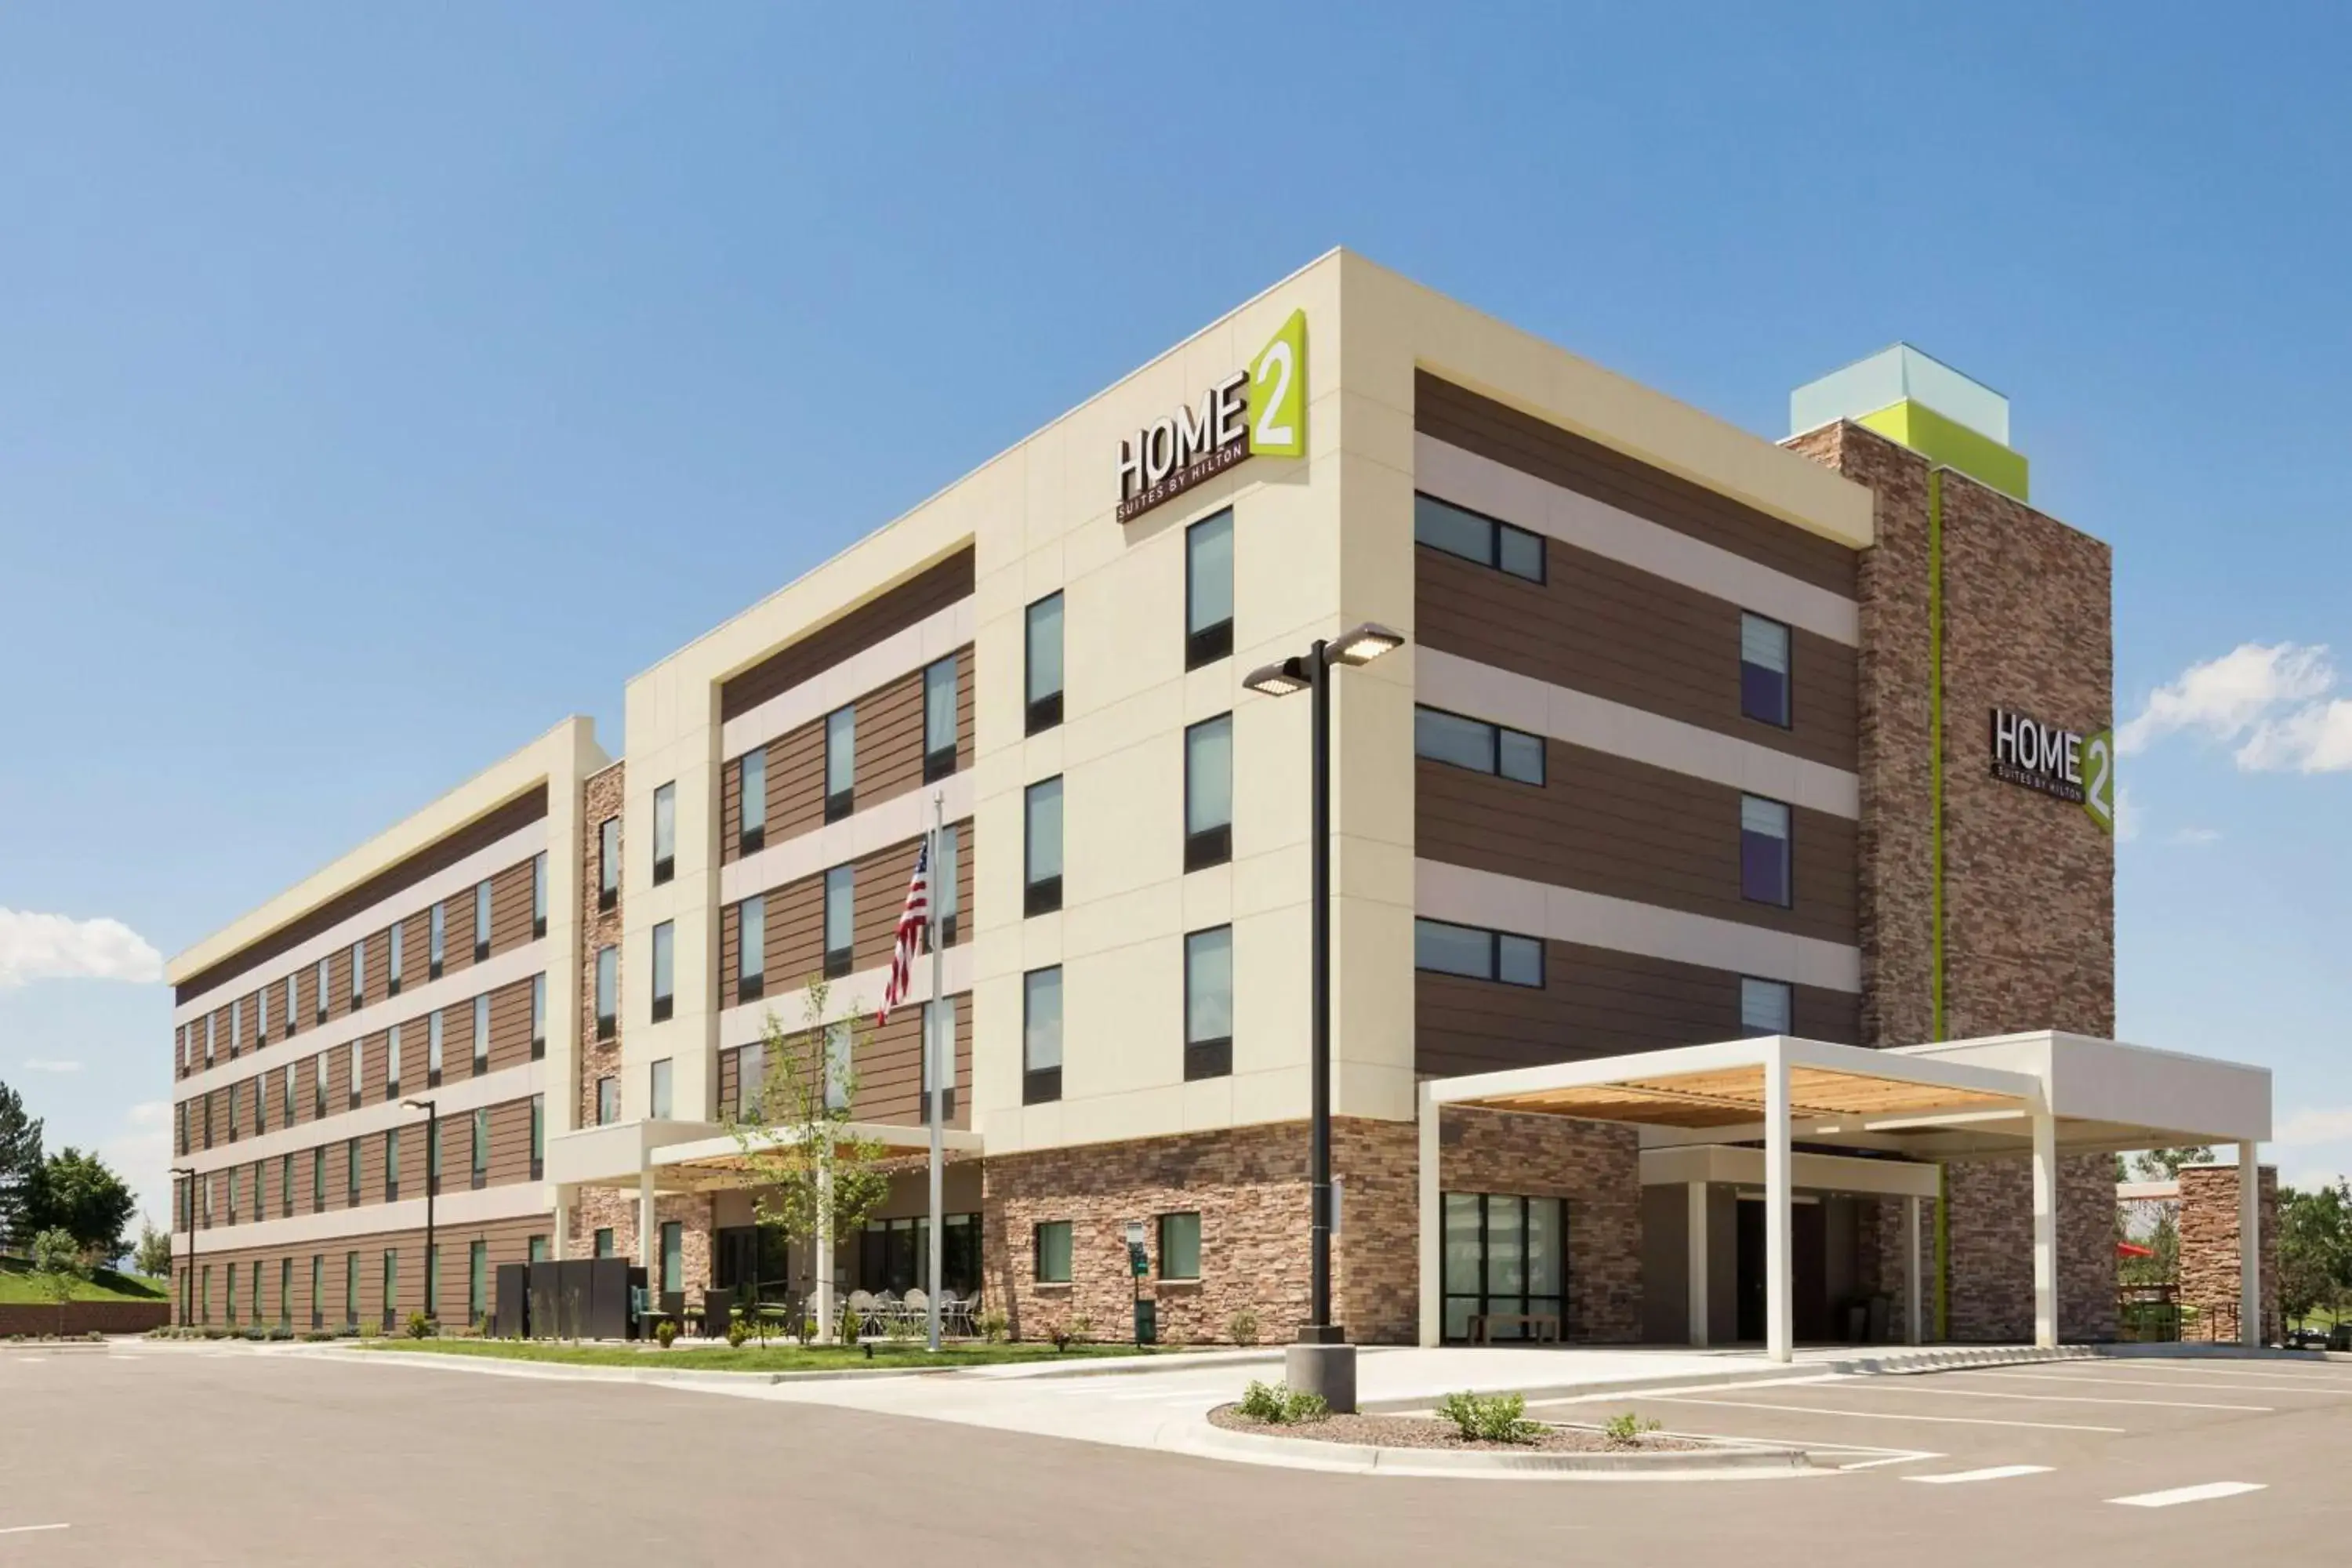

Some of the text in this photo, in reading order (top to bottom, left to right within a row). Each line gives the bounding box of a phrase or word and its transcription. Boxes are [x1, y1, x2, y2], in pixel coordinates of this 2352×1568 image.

[1118, 444, 1241, 518] SUITES BY HILTON
